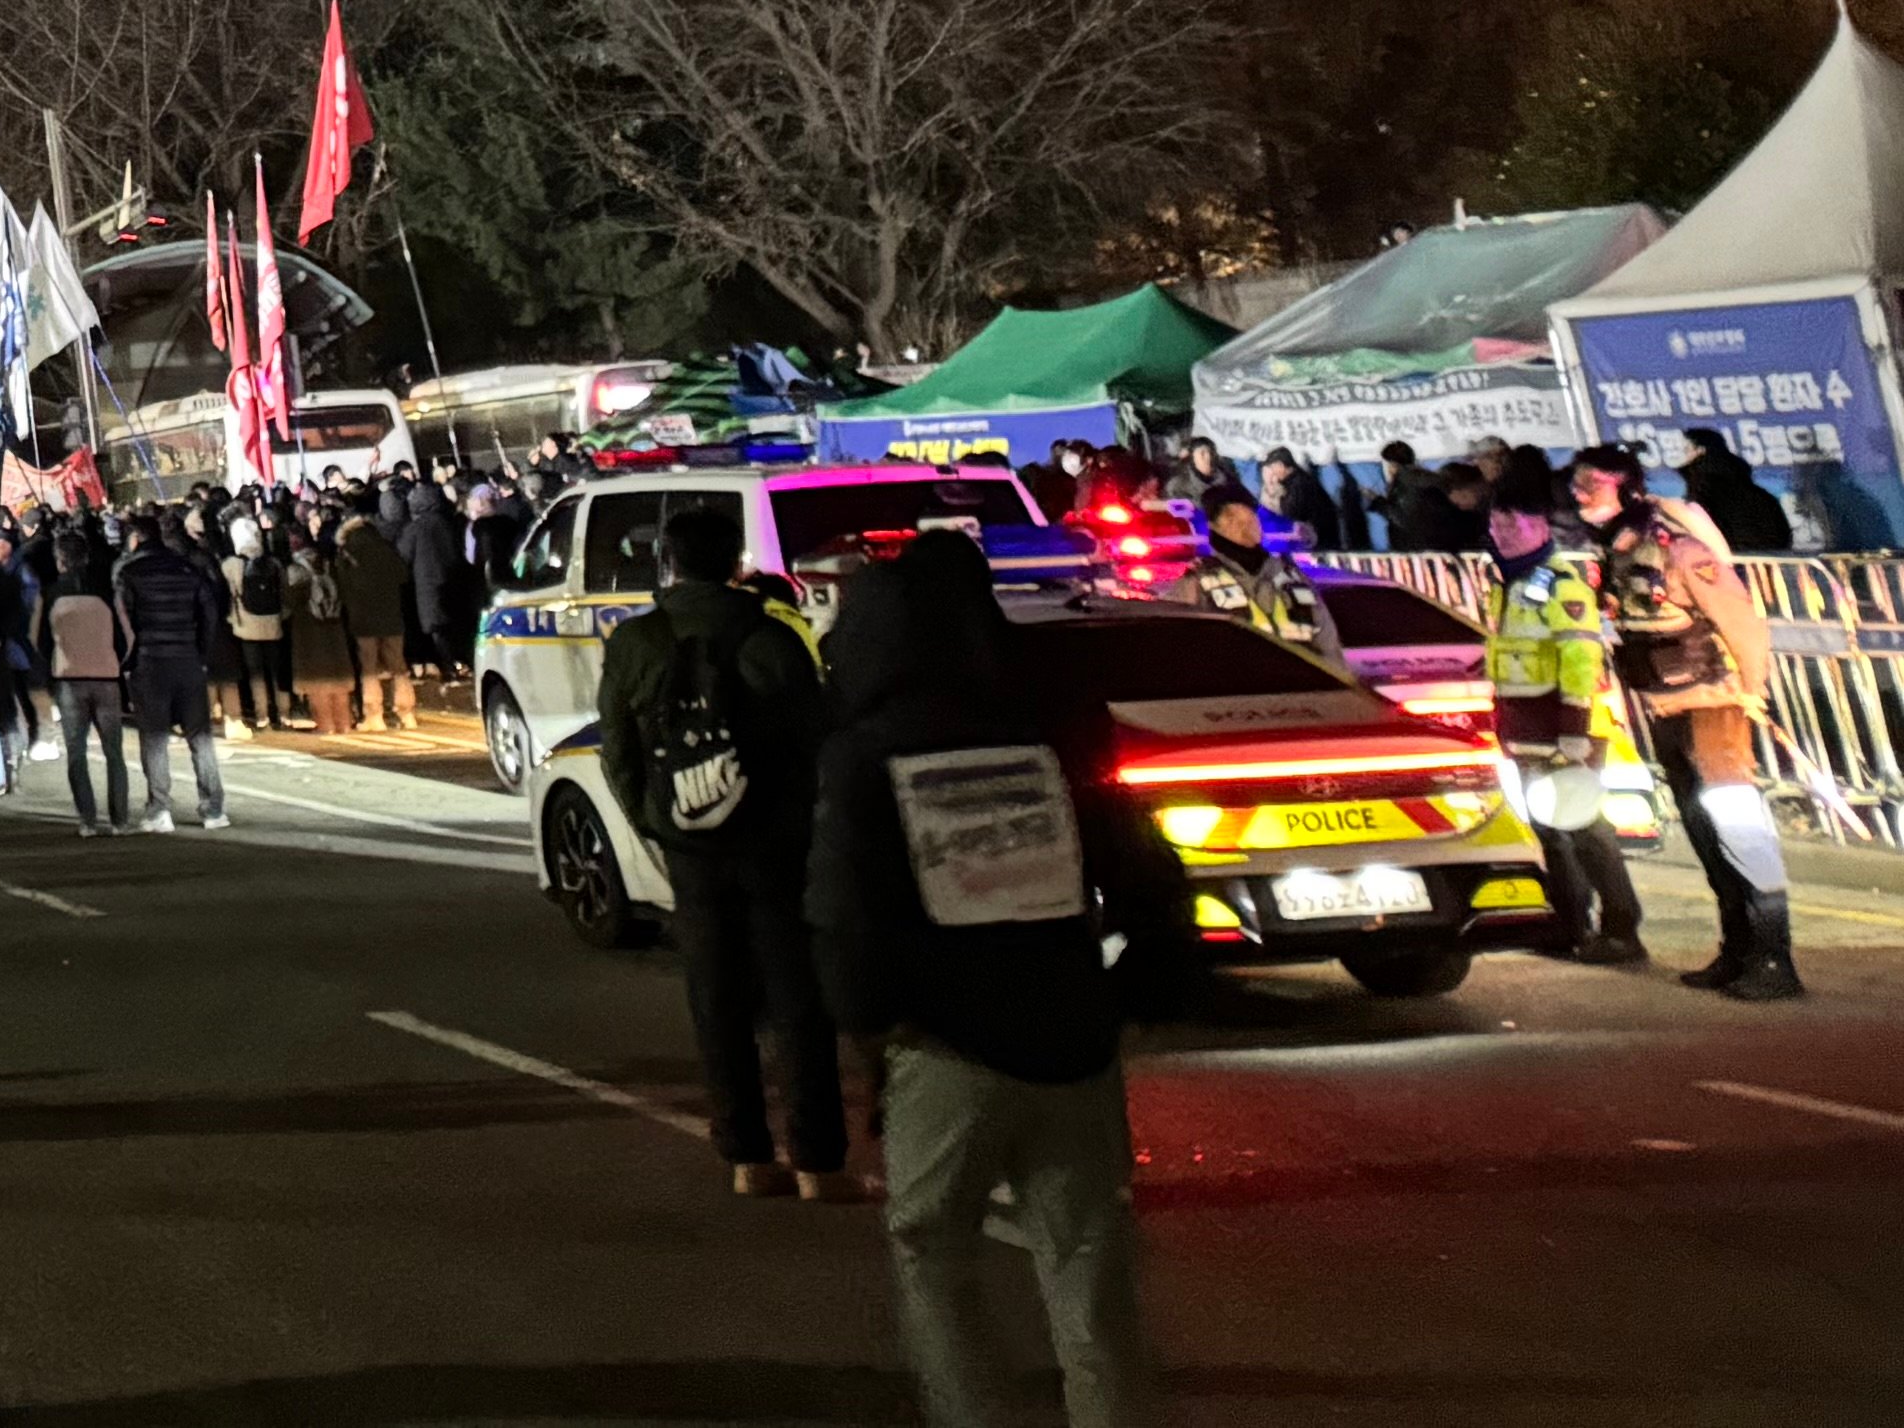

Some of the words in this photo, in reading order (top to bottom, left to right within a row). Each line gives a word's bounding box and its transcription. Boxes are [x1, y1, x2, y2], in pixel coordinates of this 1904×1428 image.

[1826, 368, 1853, 409] 수
[673, 747, 741, 815] NIKE
[1285, 806, 1379, 833] POLICE
